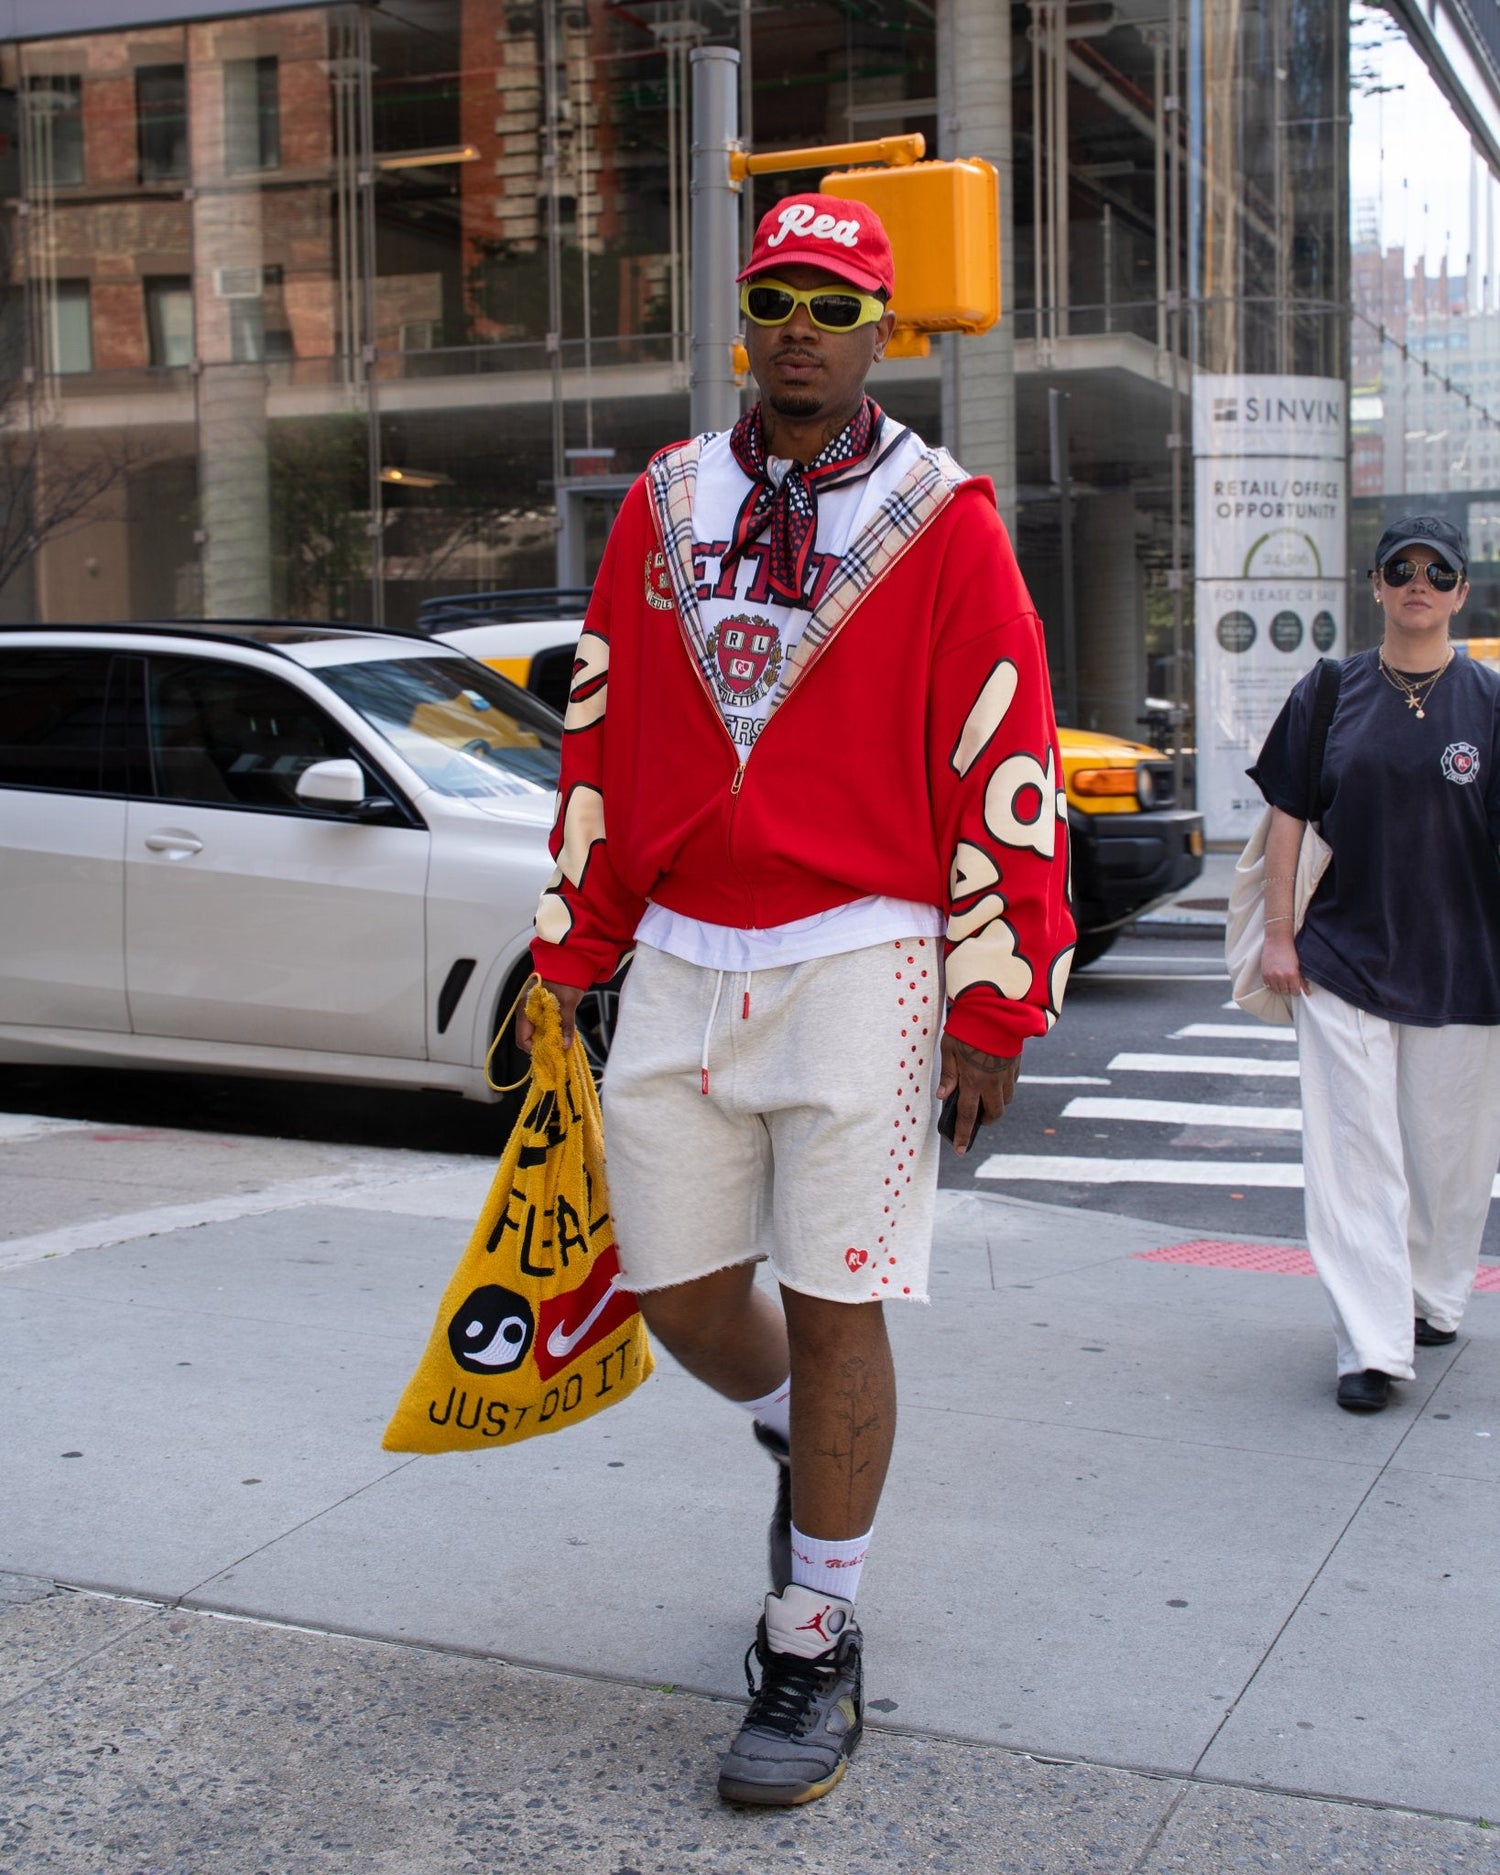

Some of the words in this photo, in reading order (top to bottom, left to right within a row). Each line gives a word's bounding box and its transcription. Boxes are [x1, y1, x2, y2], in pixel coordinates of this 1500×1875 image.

[1246, 398, 1340, 424] SINVIN
[1217, 502, 1337, 518] OPPORTUNITY
[1214, 589, 1244, 601] FOR
[1251, 589, 1291, 601] LEASE
[730, 632, 738, 645] R
[758, 637, 765, 650] L
[849, 1252, 863, 1265] RL
[428, 1387, 535, 1437] JUST
[538, 1373, 583, 1422] DO
